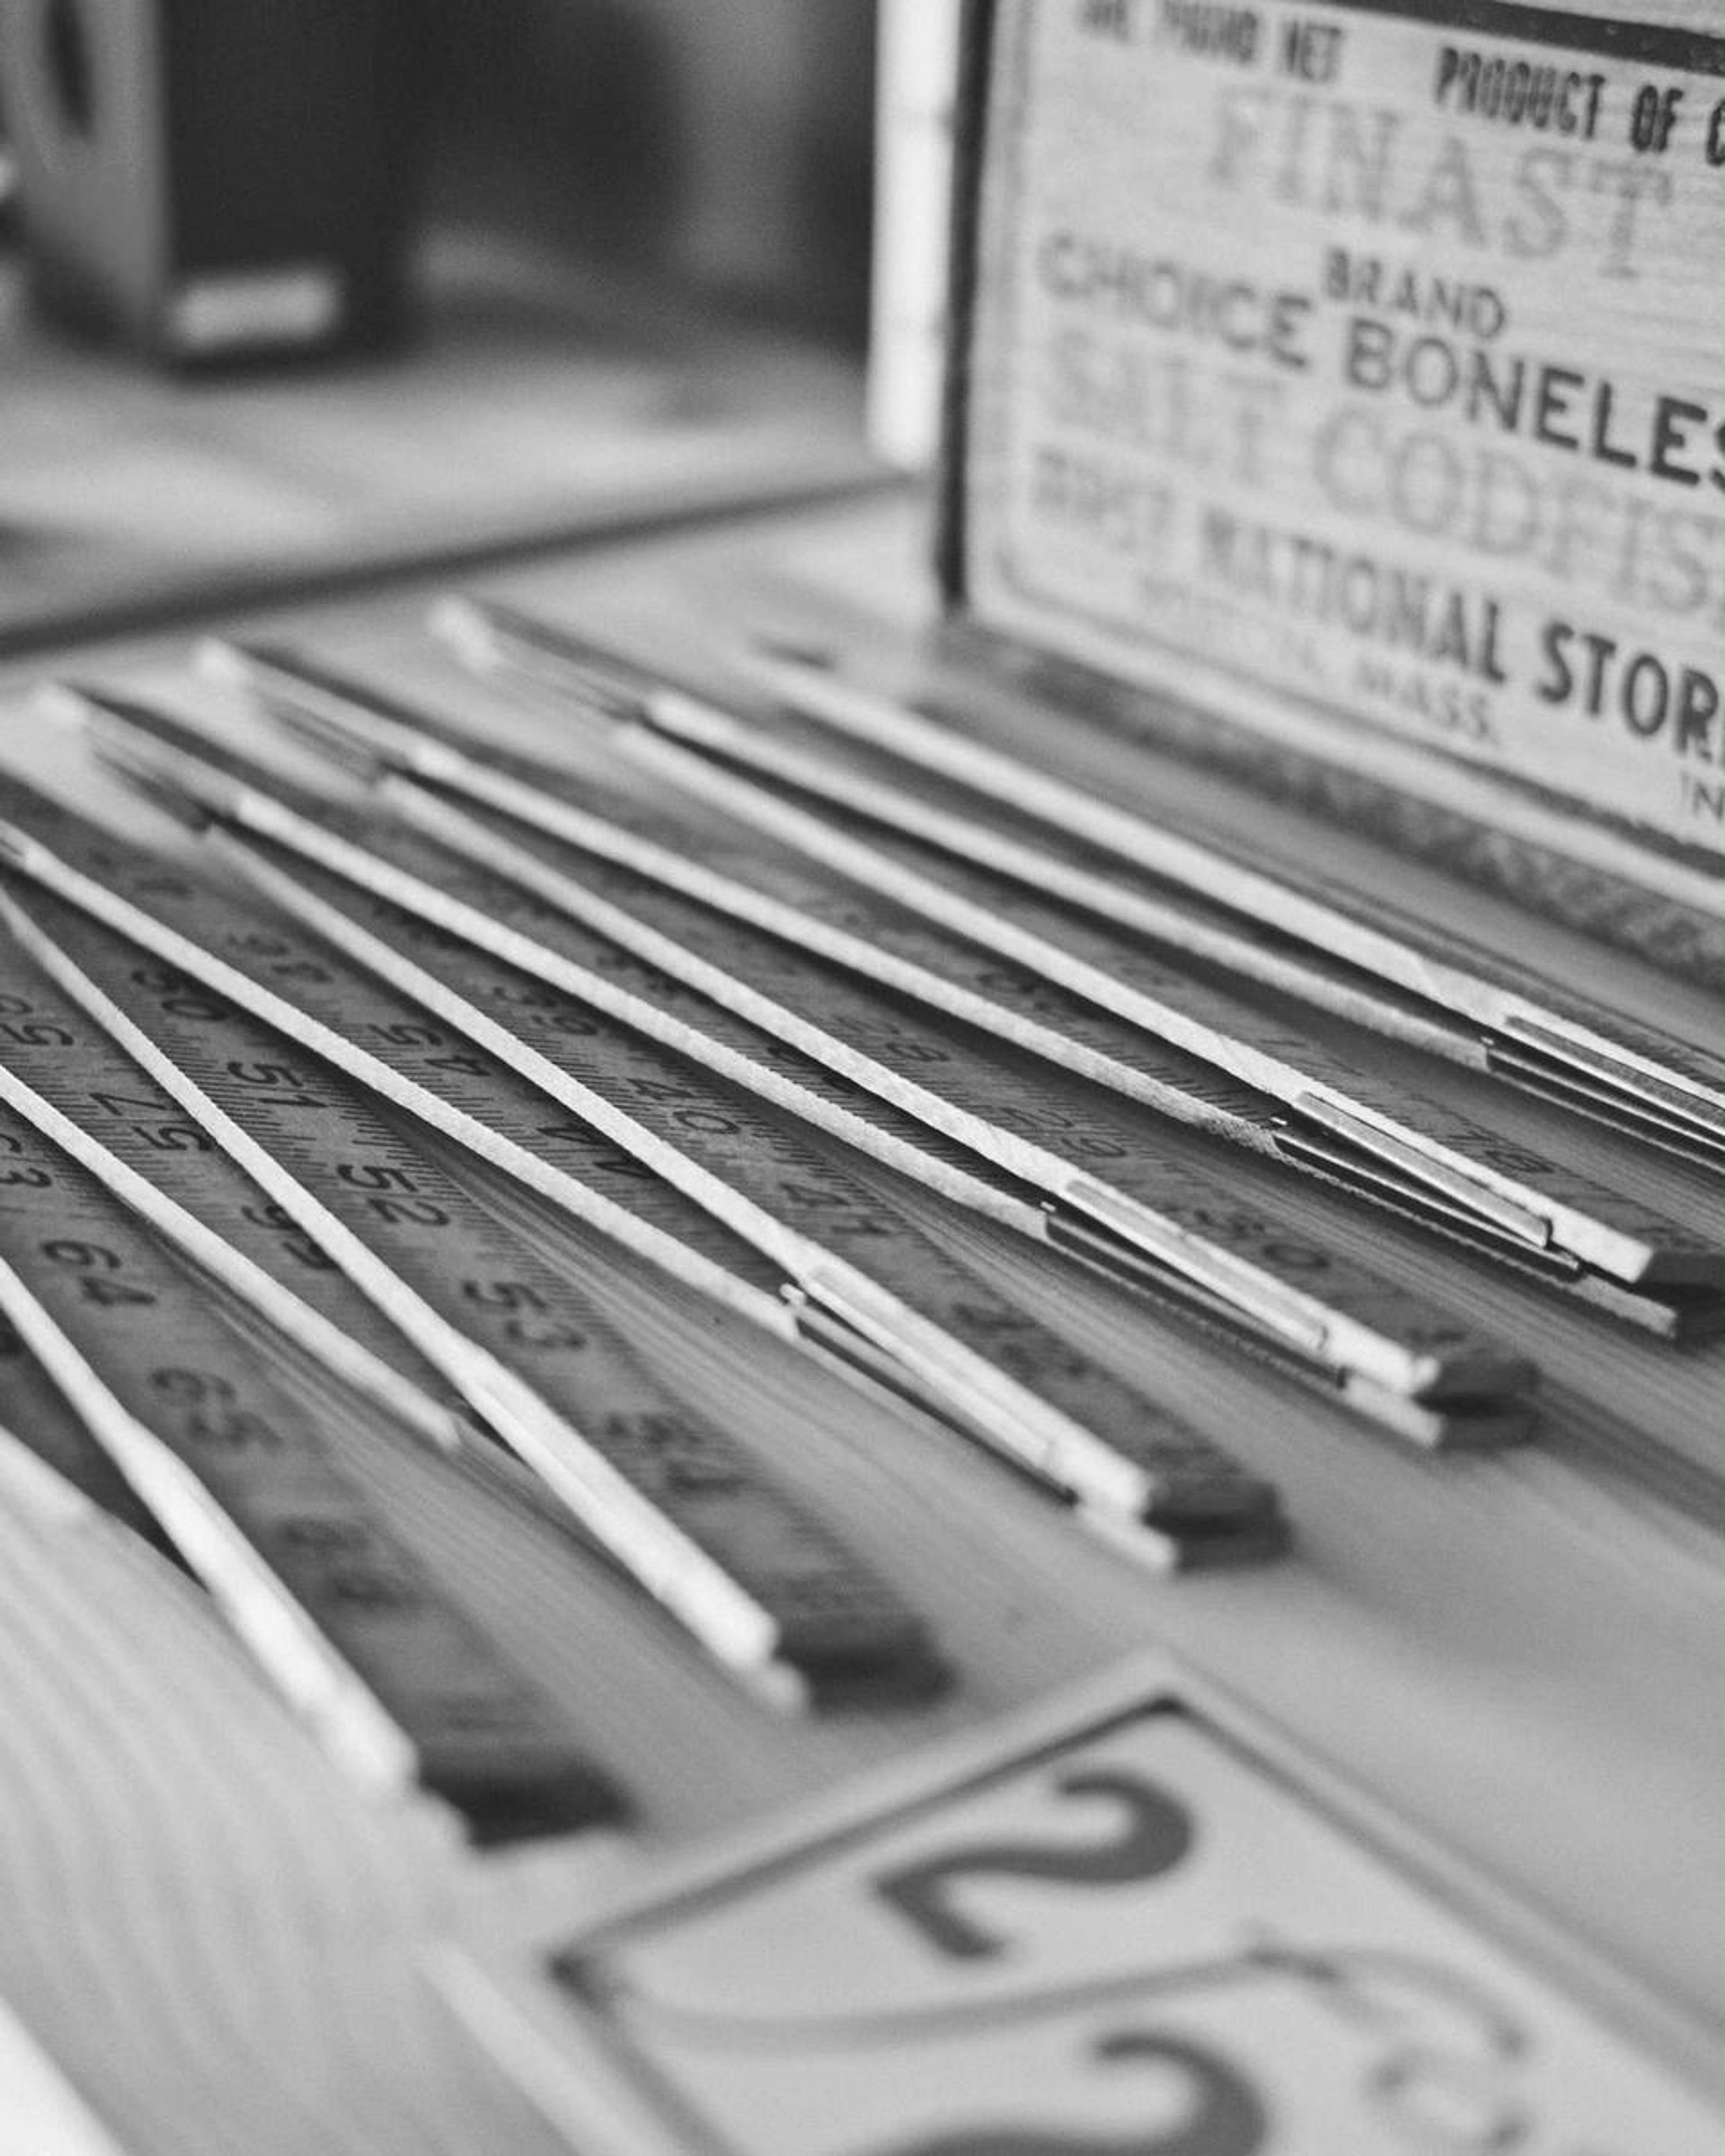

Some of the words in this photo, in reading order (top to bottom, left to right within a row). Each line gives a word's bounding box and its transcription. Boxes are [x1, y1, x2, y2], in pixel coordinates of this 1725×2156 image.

[1435, 46, 1606, 141] PRODUCT
[1631, 84, 1685, 153] OF
[1208, 84, 1673, 281] FINAST
[1036, 231, 1314, 374] CHOICE
[1324, 245, 1508, 339] BRAND
[1201, 504, 1508, 685] NATIONAL
[1537, 621, 1725, 766] STOR
[368, 1023, 489, 1076] 45
[227, 1061, 328, 1108] 51
[626, 1079, 740, 1133] 40
[90, 1093, 212, 1151] 57
[337, 1165, 450, 1227] 52
[40, 1240, 156, 1305] 64
[462, 1280, 588, 1349] 53
[869, 1769, 1197, 1957] 2
